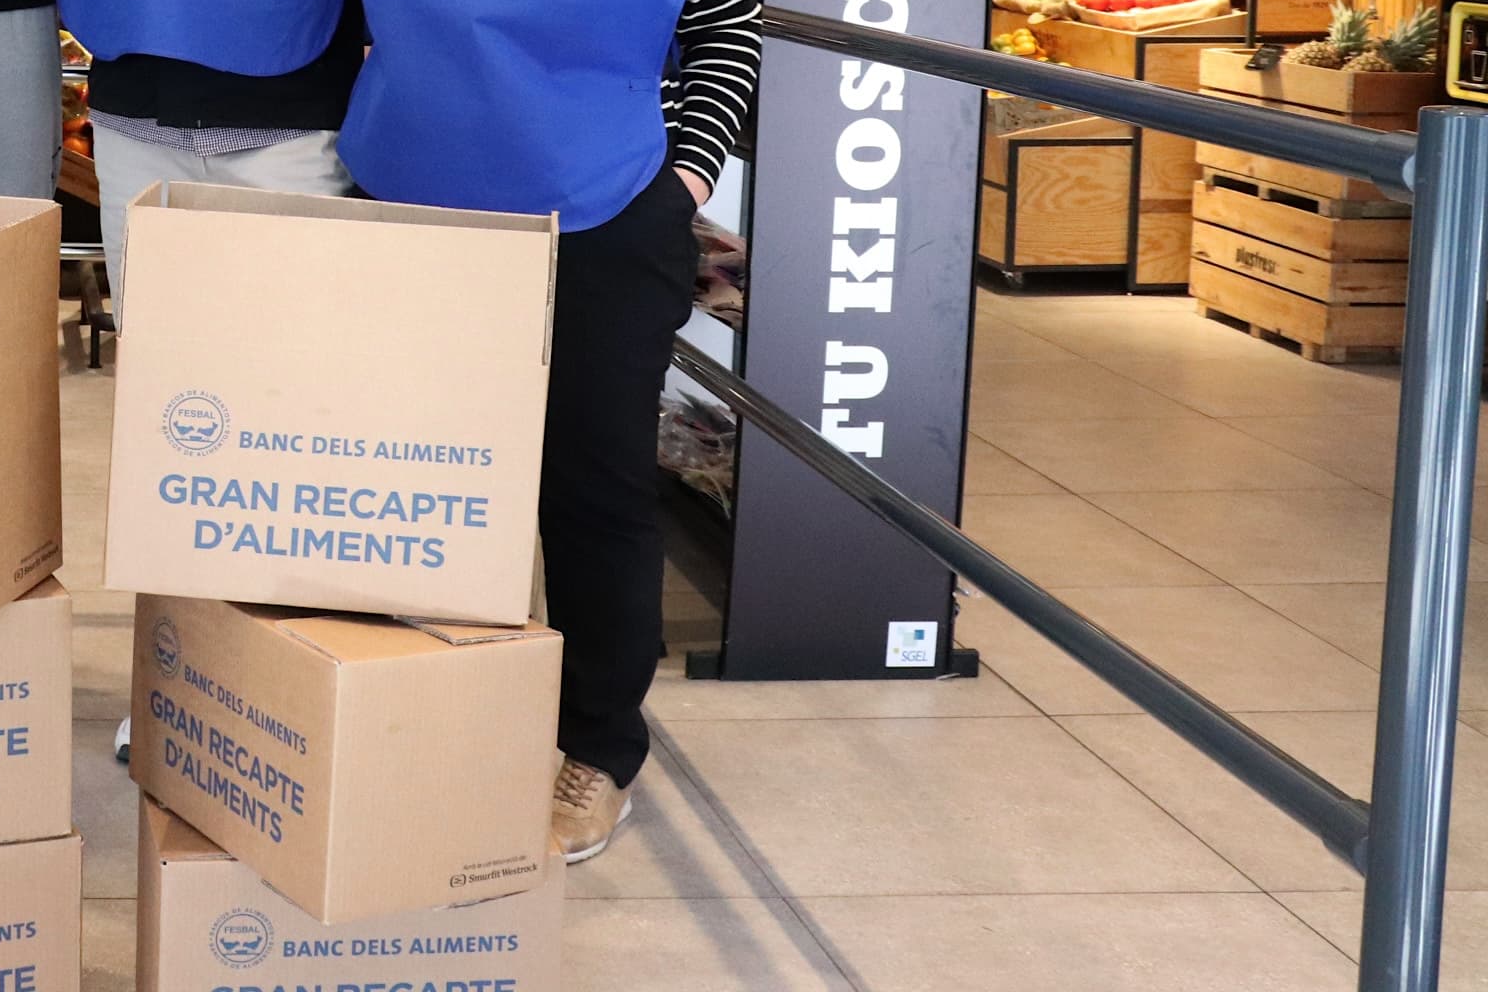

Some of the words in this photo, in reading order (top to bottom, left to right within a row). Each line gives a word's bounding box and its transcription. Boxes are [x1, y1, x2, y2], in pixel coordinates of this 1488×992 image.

[178, 409, 215, 419] FESBAL
[821, 341, 889, 458] TU
[239, 431, 304, 453] BANC
[311, 436, 366, 457] DELS
[373, 441, 493, 466] ALIMENTS
[159, 474, 279, 512] GRAN
[293, 484, 489, 528] RECAPTE
[194, 519, 445, 568] D'ALIMENTS
[901, 649, 928, 662] SGEL
[184, 665, 214, 698] BANC
[217, 685, 243, 716] DELS
[246, 705, 307, 755] ALIMENTS
[150, 689, 203, 748] GRAN
[209, 726, 305, 816] RECAPTE
[165, 738, 282, 844] D'ALIMENTS
[468, 870, 500, 883] Smurfit
[502, 861, 537, 877] Westrock
[224, 926, 260, 934] FESBAL
[283, 940, 343, 957] BANC
[351, 938, 402, 956] DELS
[409, 935, 518, 954] ALIMENTS
